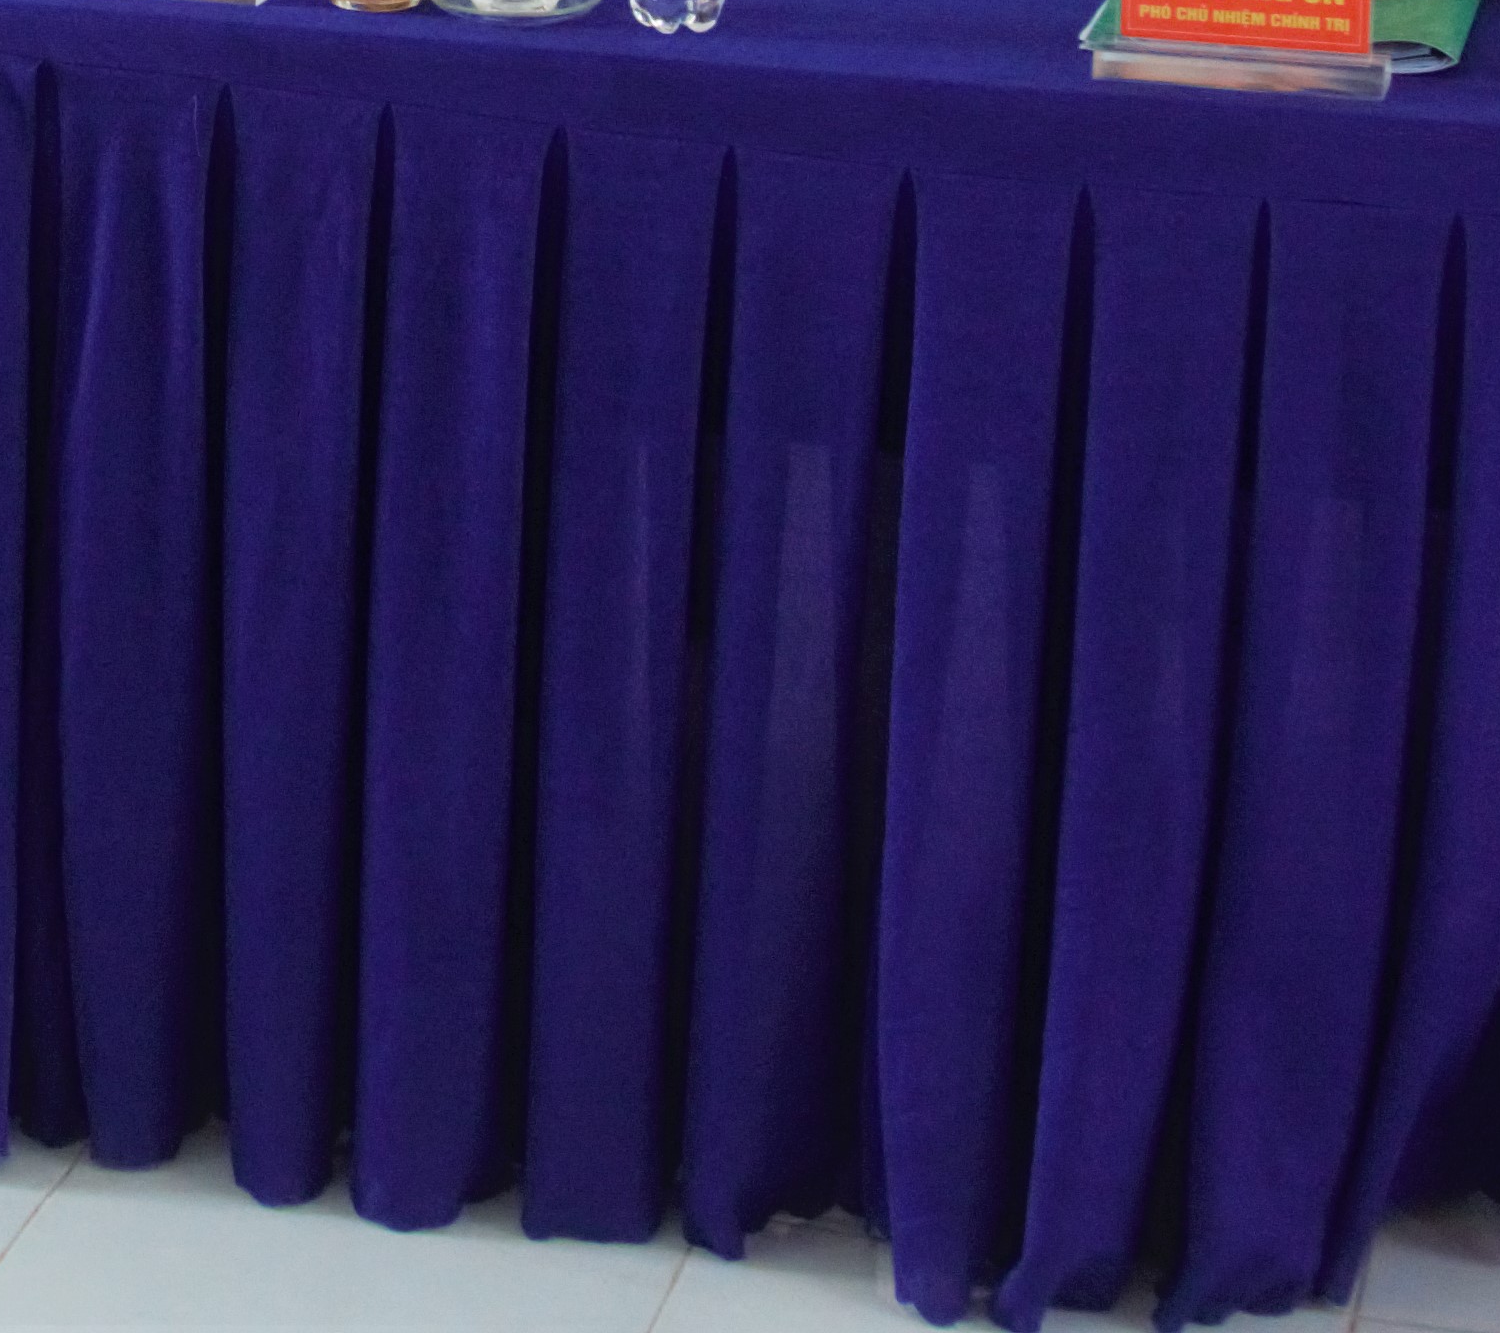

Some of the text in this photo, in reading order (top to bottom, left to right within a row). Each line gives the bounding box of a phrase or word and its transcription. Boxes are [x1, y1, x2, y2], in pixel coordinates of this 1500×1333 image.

[1139, 3, 1350, 35] PHÓ CHỦ NHIỆM CHÍNH TRỊ
